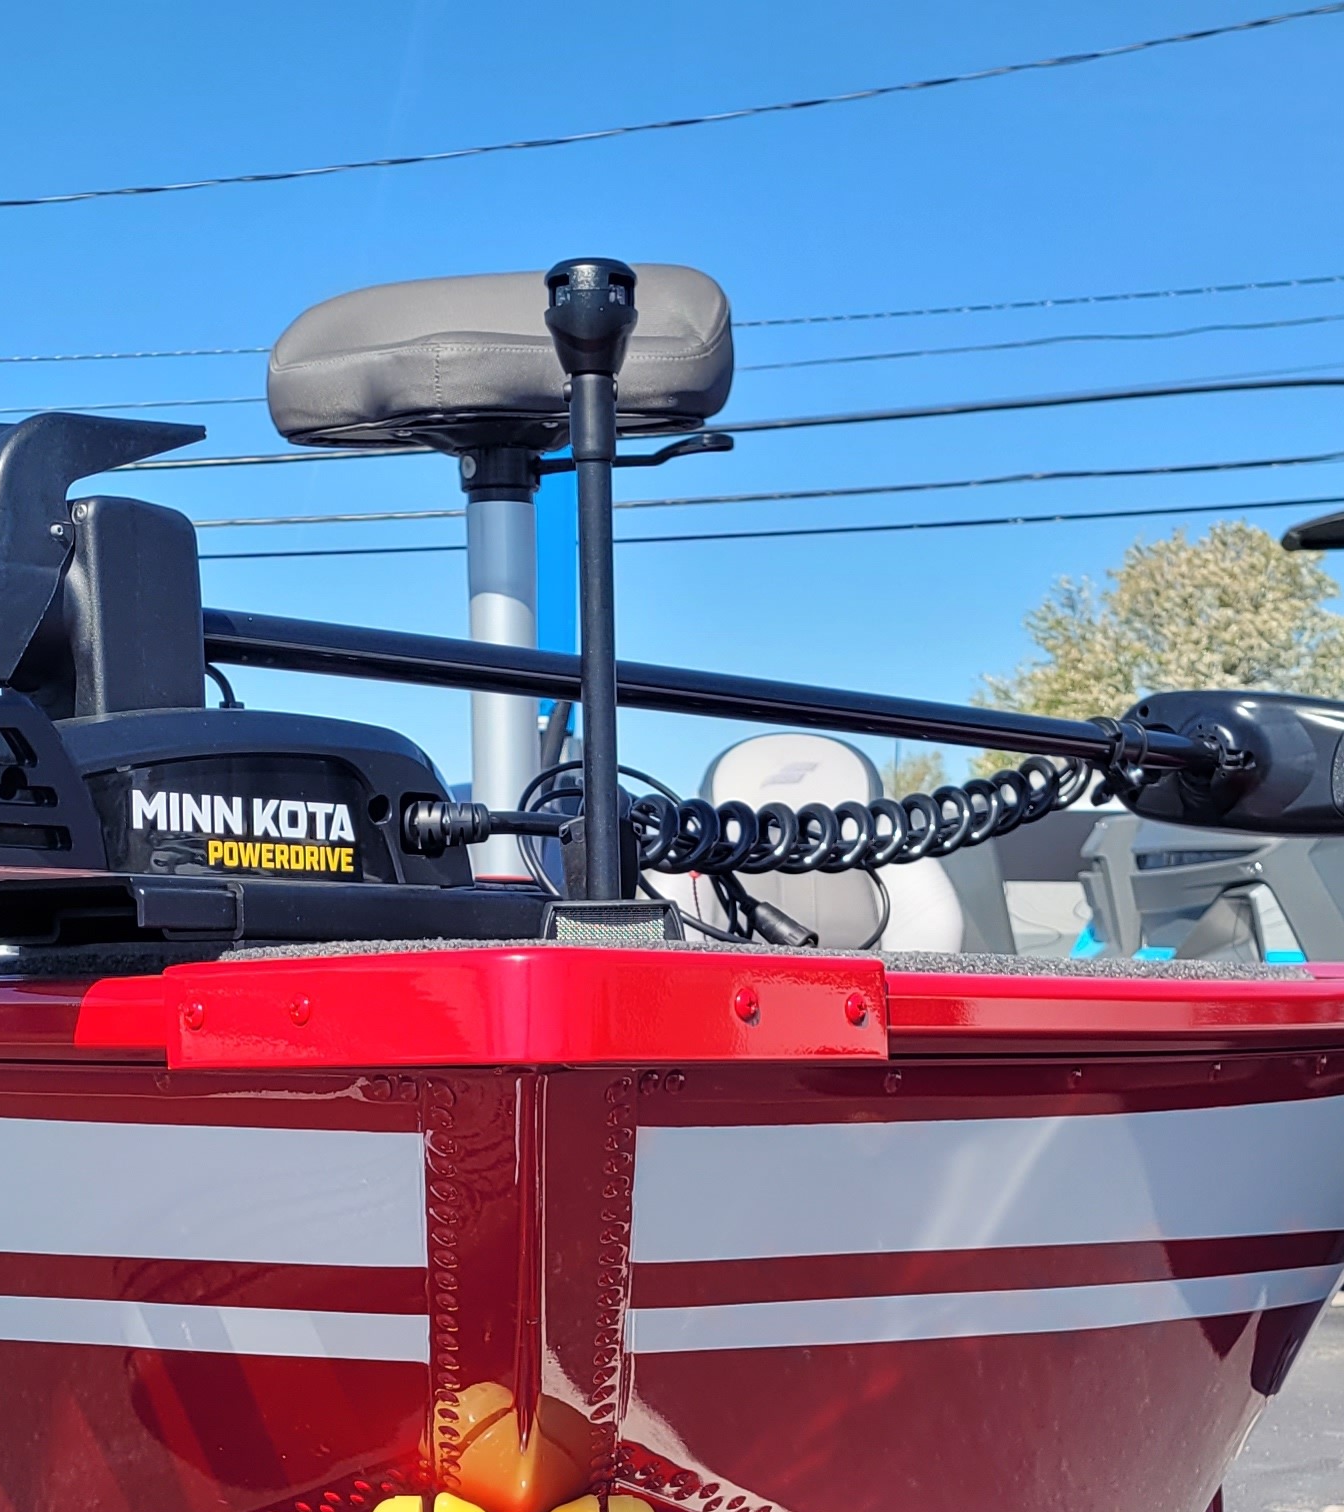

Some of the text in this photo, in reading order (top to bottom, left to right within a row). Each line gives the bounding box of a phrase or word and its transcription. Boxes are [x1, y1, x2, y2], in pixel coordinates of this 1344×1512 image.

[131, 789, 355, 842] MINN KOTA
[208, 840, 354, 872] POWERDRIVE
